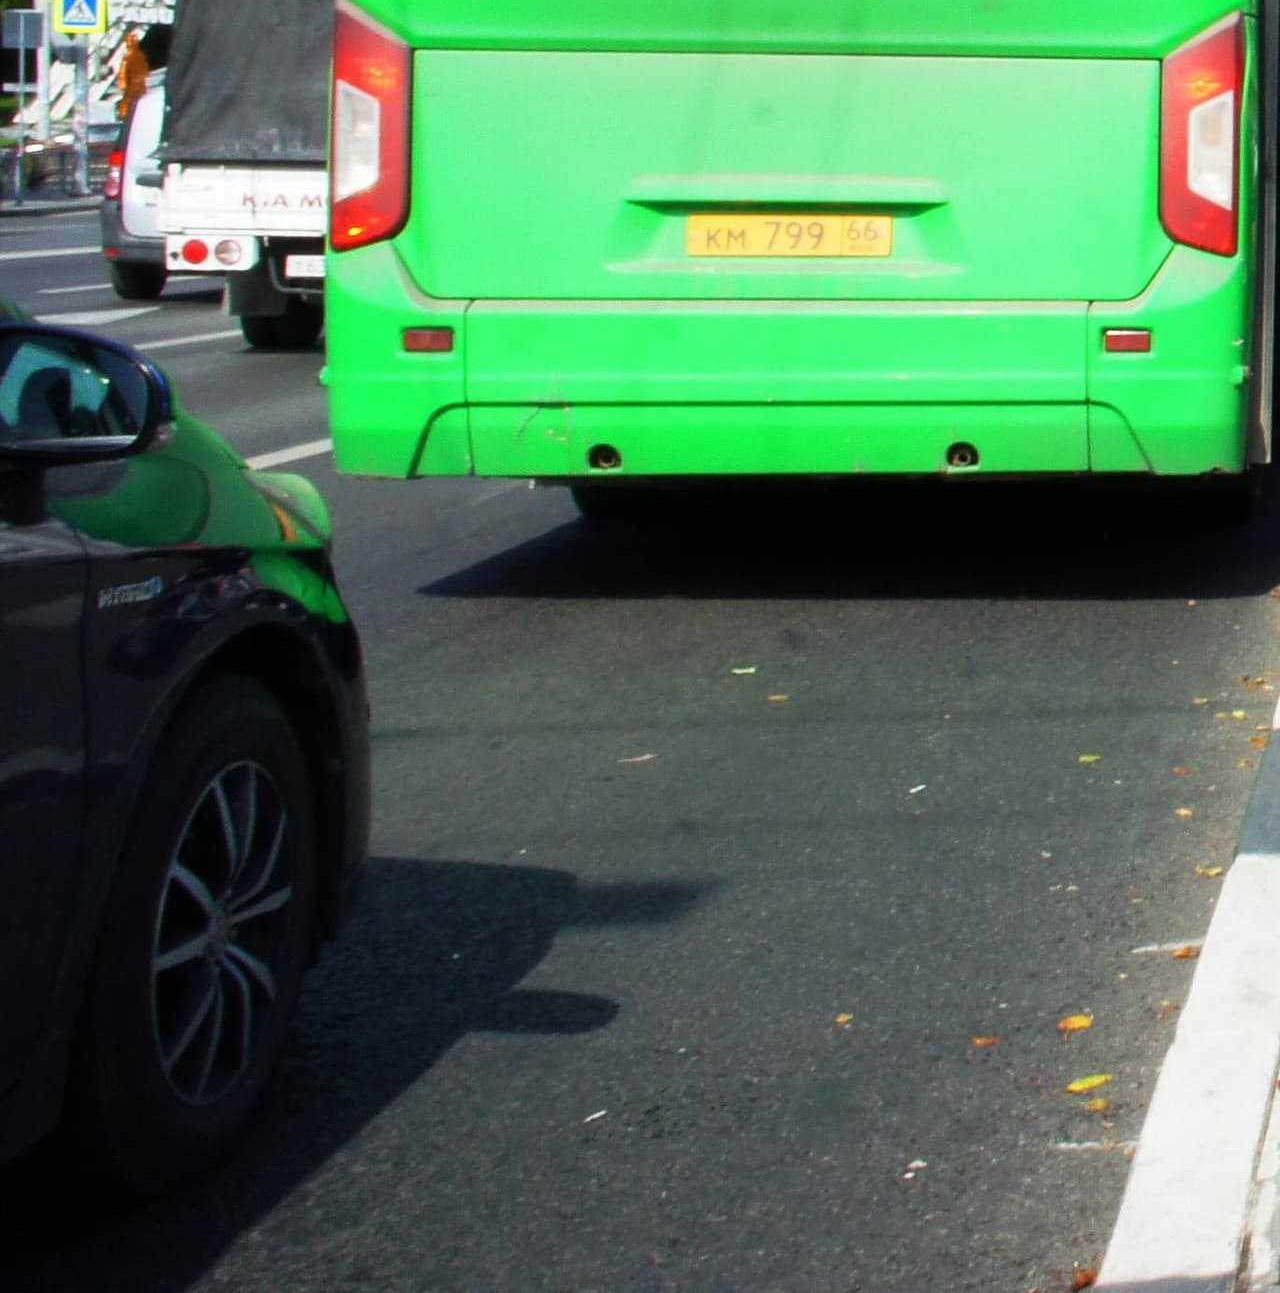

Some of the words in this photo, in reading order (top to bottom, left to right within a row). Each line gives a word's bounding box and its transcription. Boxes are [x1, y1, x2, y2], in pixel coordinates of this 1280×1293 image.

[705, 228, 747, 250] КМ
[765, 222, 825, 249] 799
[847, 219, 878, 241] 66
